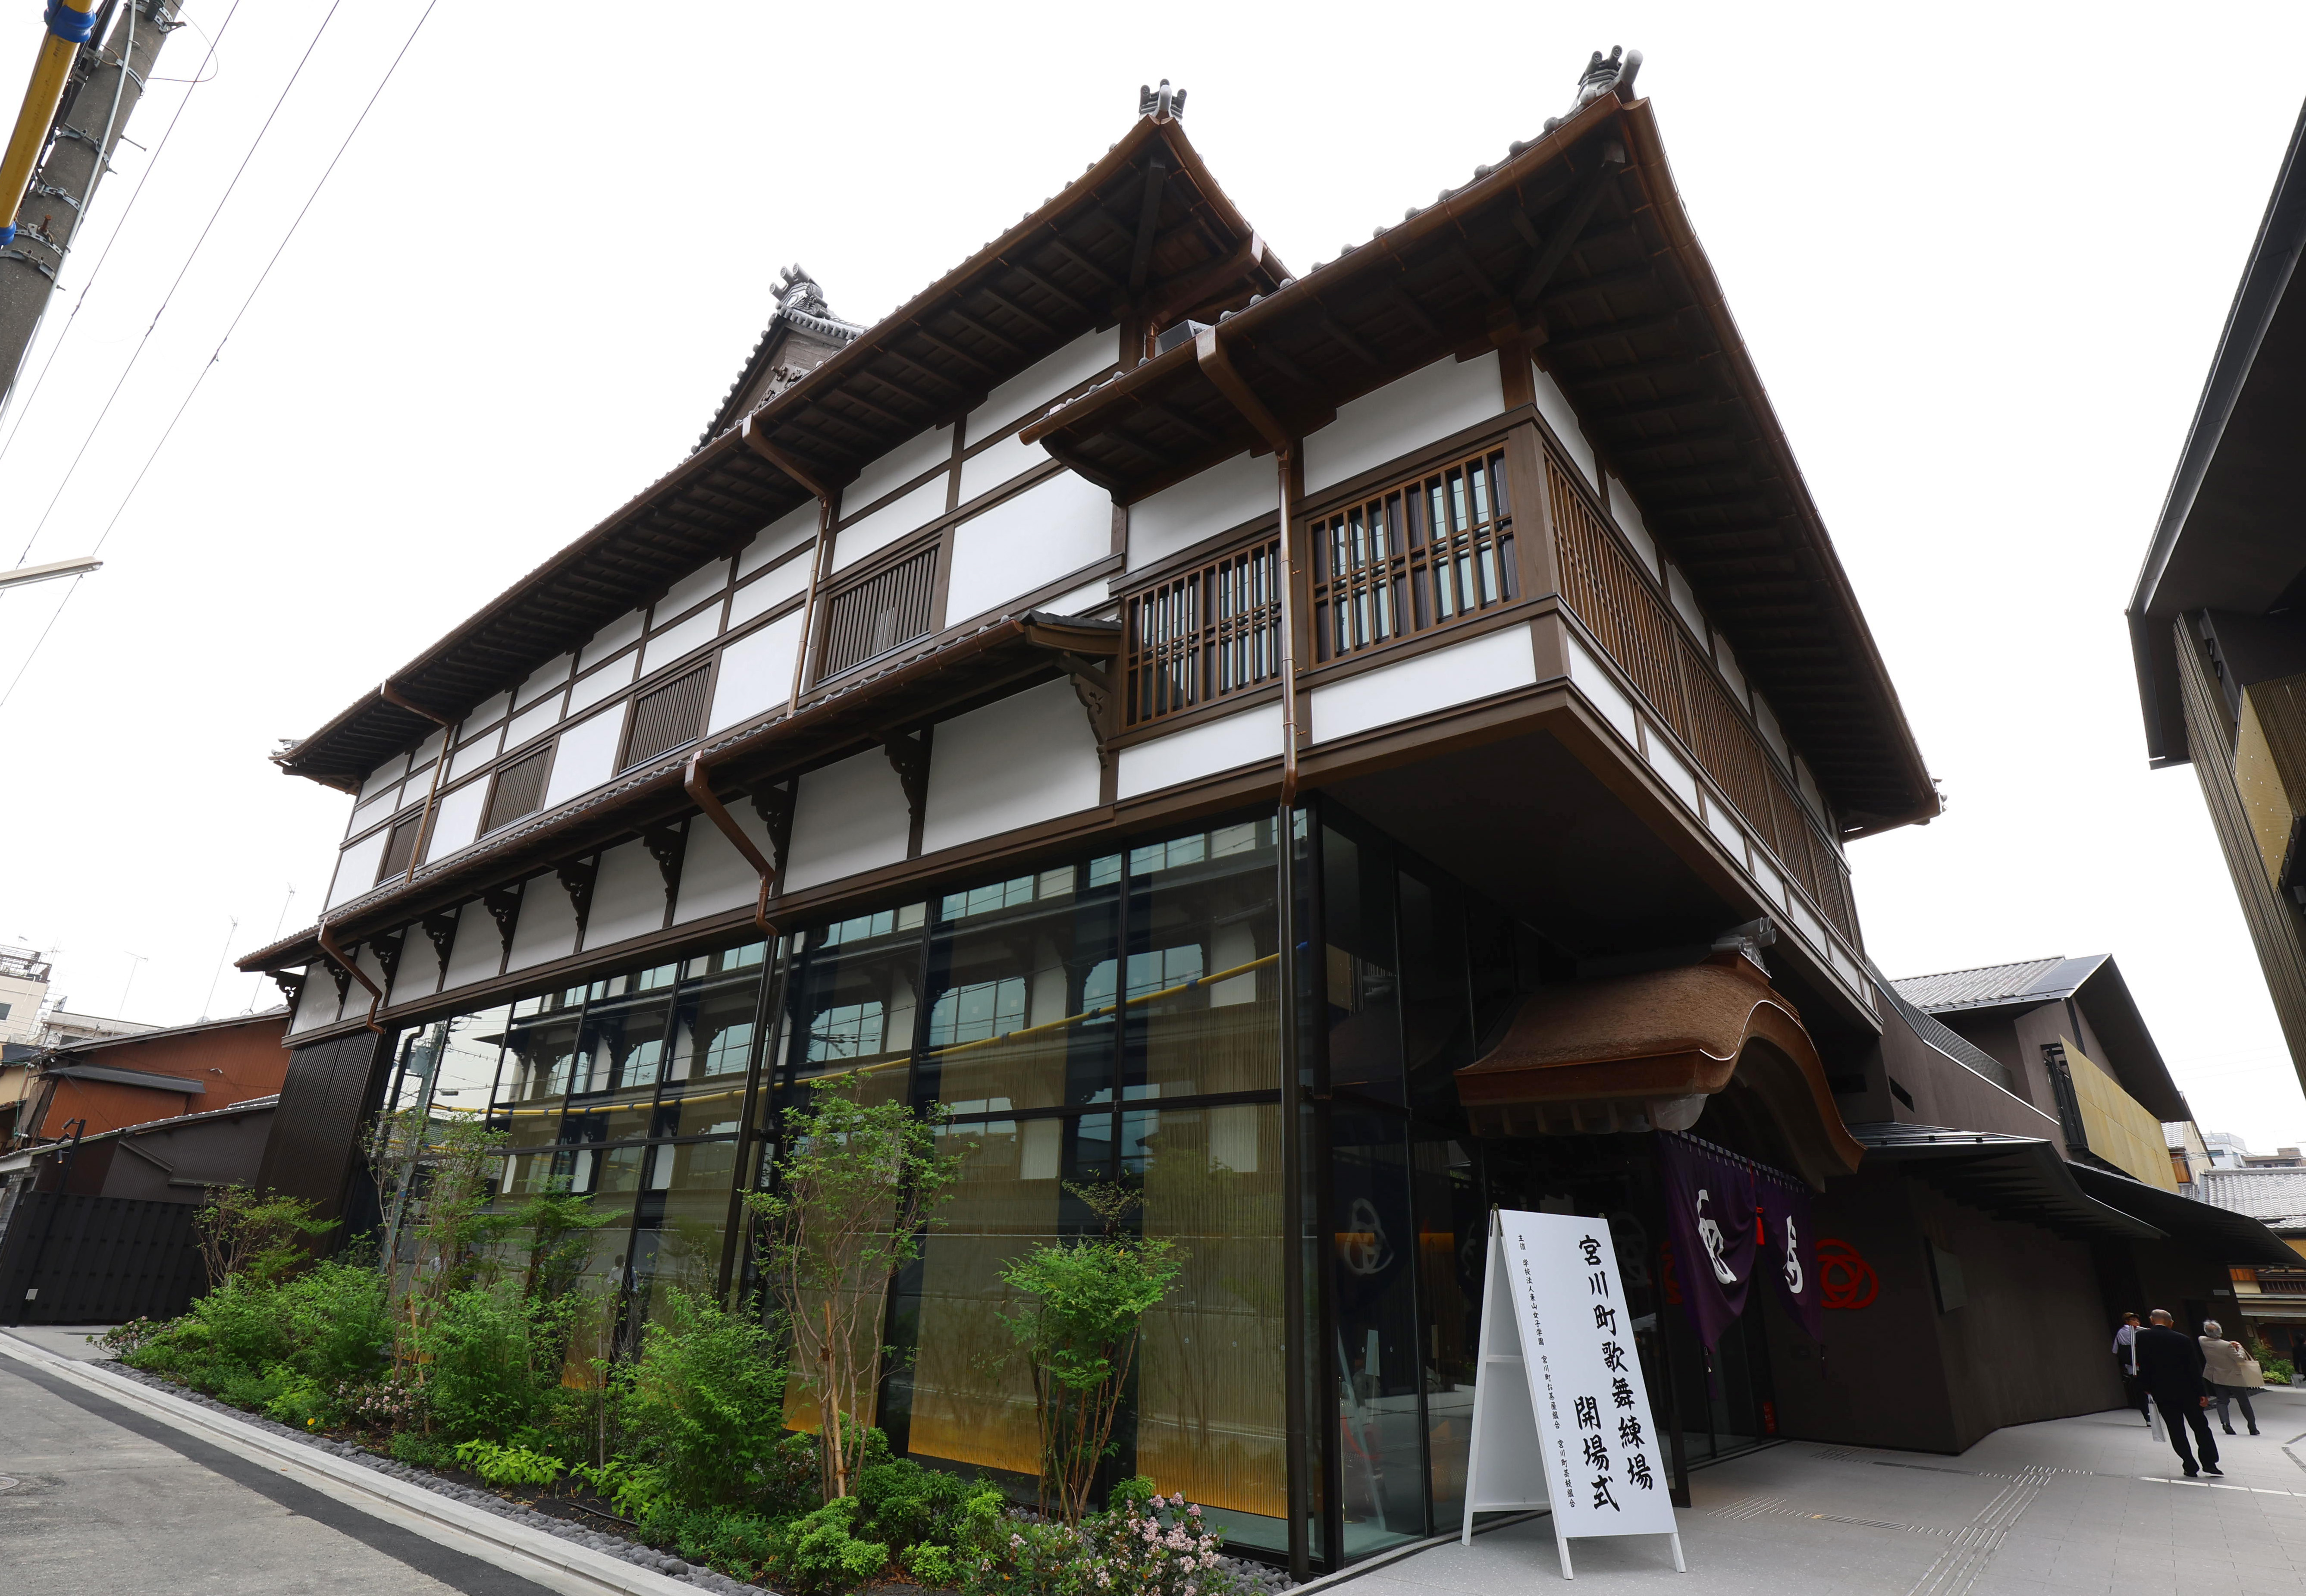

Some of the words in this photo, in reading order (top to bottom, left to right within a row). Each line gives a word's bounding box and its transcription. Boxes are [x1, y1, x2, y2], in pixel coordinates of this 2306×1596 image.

[1518, 1234, 1526, 1250] 主催
[1522, 1259, 1544, 1345] 学校法人東山女子学園
[1541, 1355, 1560, 1429] 宮川町お茶屋組合
[1557, 1439, 1575, 1508] 宮川町芸妓組合
[1573, 1396, 1620, 1512] 開場式
[1578, 1234, 1653, 1490] 宮川町歌舞練場
